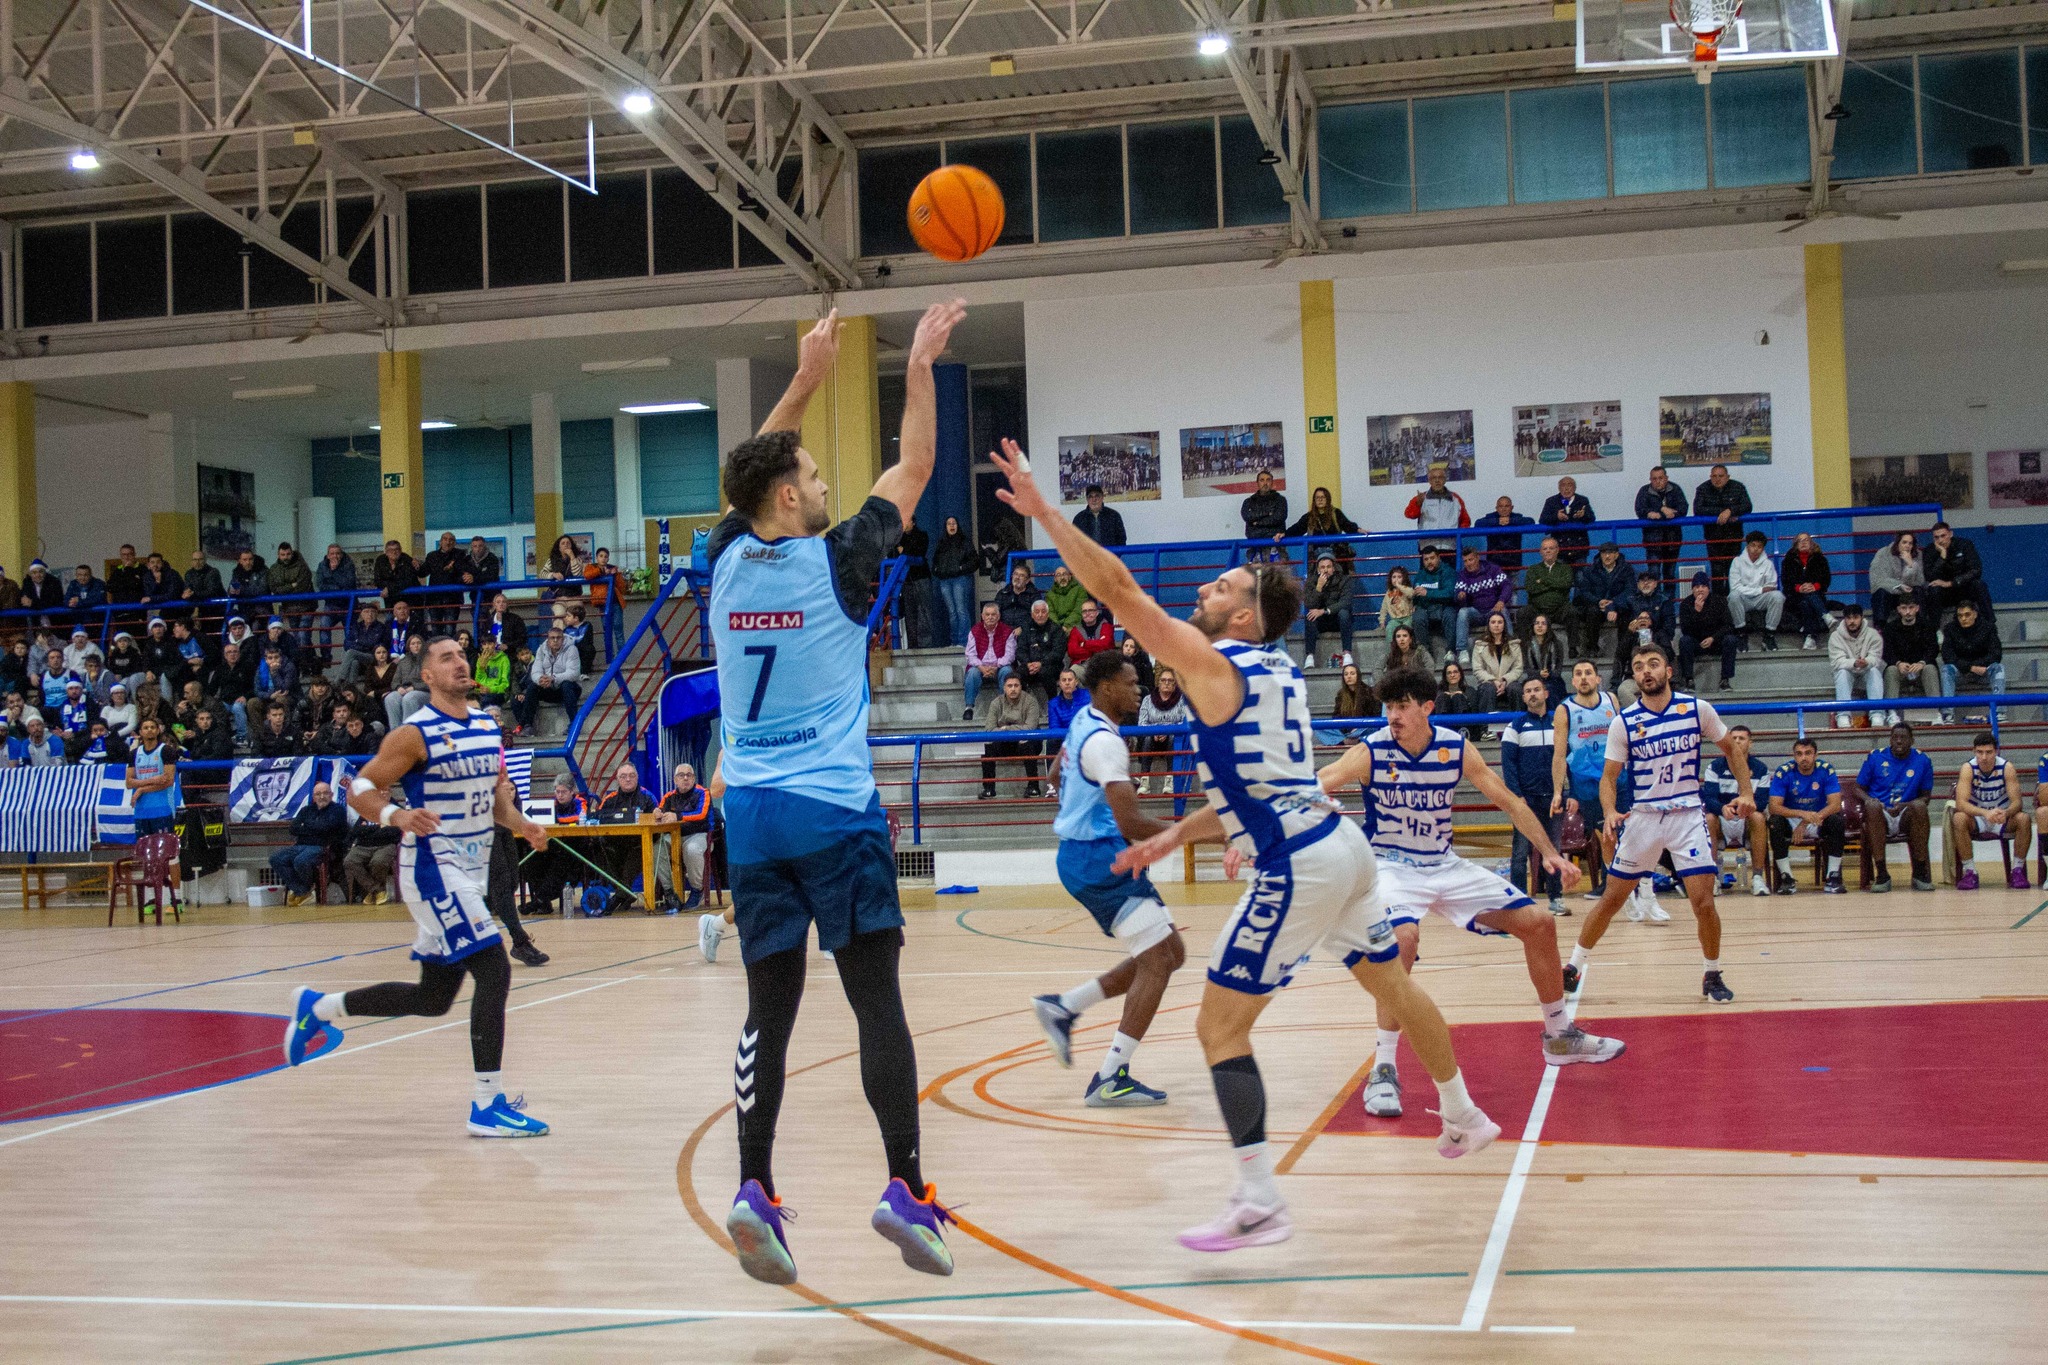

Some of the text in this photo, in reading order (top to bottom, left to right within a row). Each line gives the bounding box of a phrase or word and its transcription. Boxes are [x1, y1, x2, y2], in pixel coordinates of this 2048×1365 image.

[741, 614, 801, 629] UCLM
[744, 645, 777, 722] 7
[1282, 686, 1306, 763] 5
[1593, 741, 1599, 752] 0
[1632, 733, 1697, 759] NÁUTICO
[1659, 764, 1673, 784] 13
[471, 790, 490, 817] 23
[1233, 871, 1287, 953] RCNT
